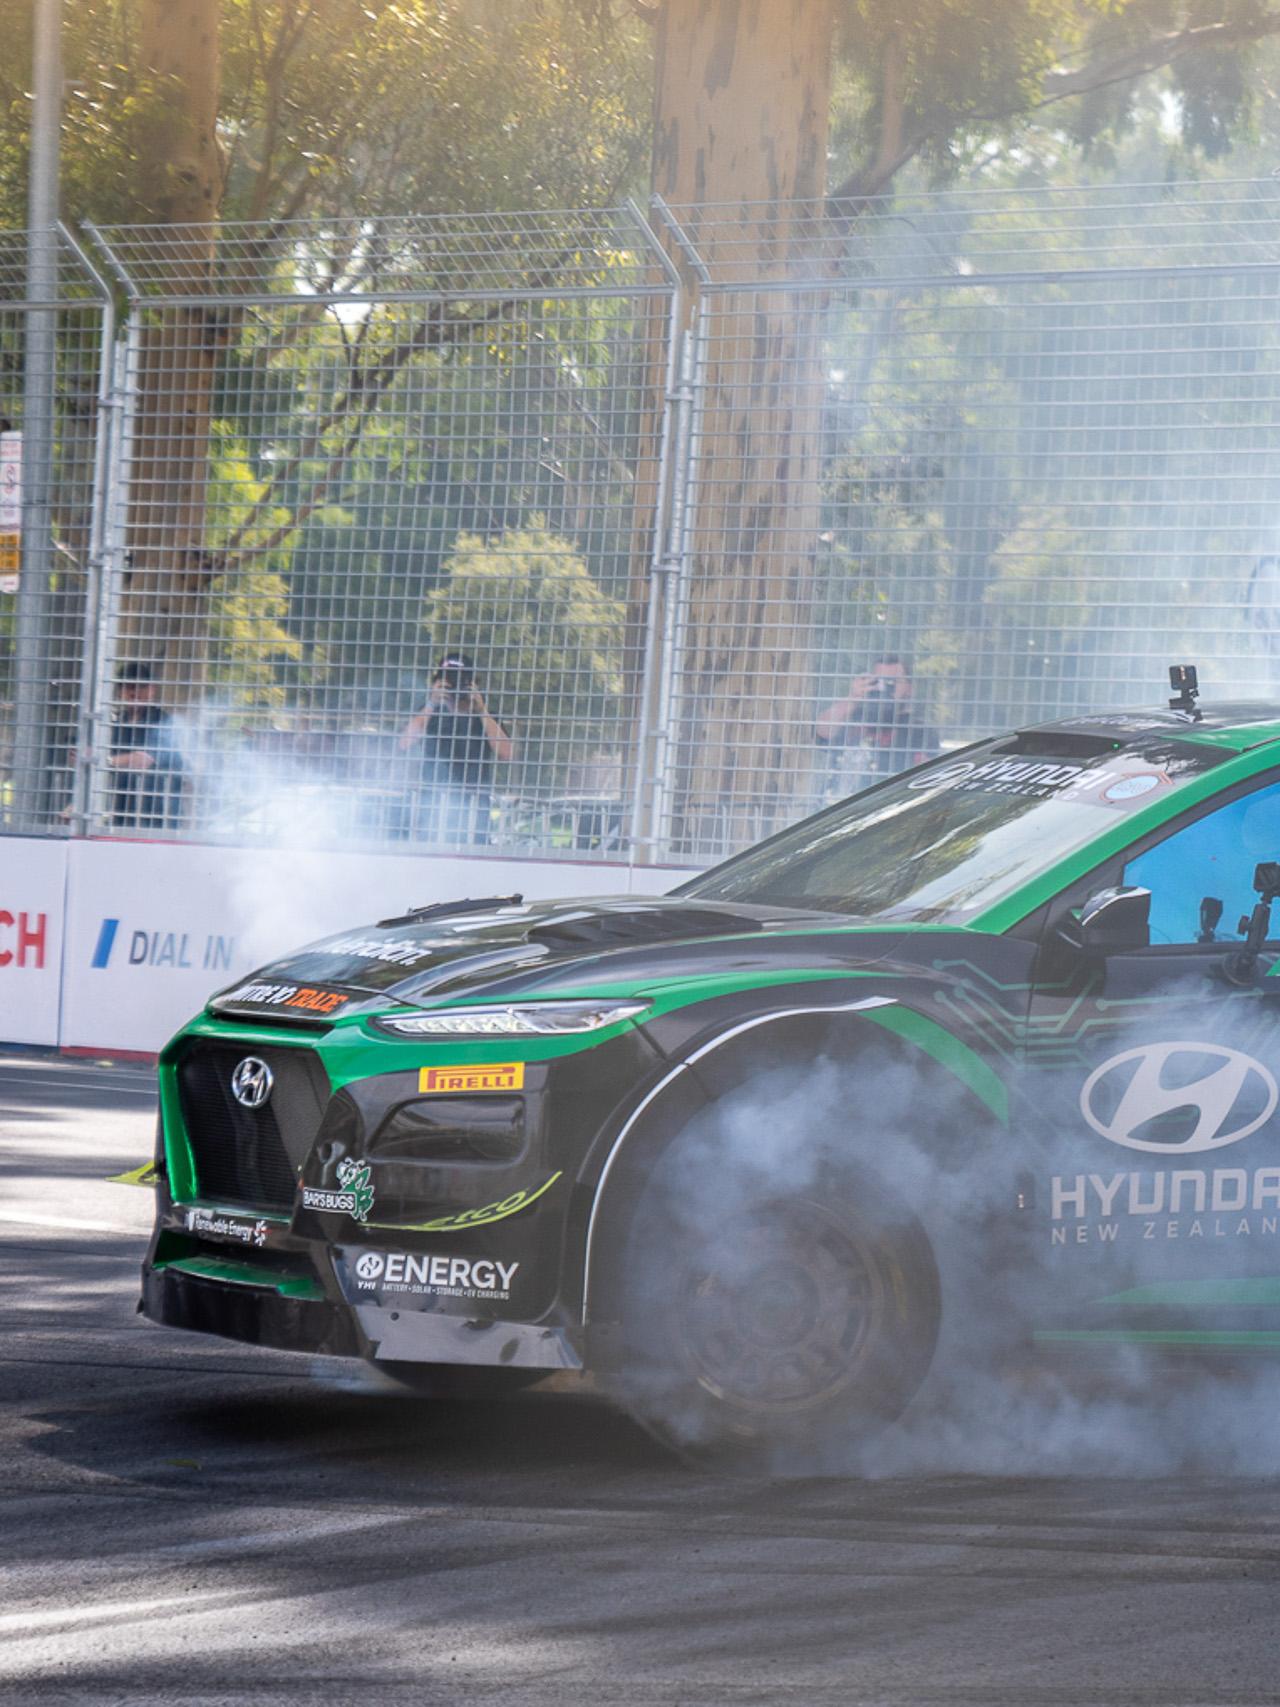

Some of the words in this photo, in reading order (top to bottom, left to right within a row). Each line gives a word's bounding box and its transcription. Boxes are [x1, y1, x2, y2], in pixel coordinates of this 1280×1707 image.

[974, 755, 1116, 790] HYUNDAI
[128, 930, 192, 969] DIAL
[203, 934, 235, 971] IN
[284, 987, 349, 1013] TRADE
[427, 1066, 516, 1090] PIRELLI
[327, 1193, 355, 1210] BUGS
[1051, 1223, 1119, 1245] NEW
[384, 1252, 520, 1291] ENERGY
